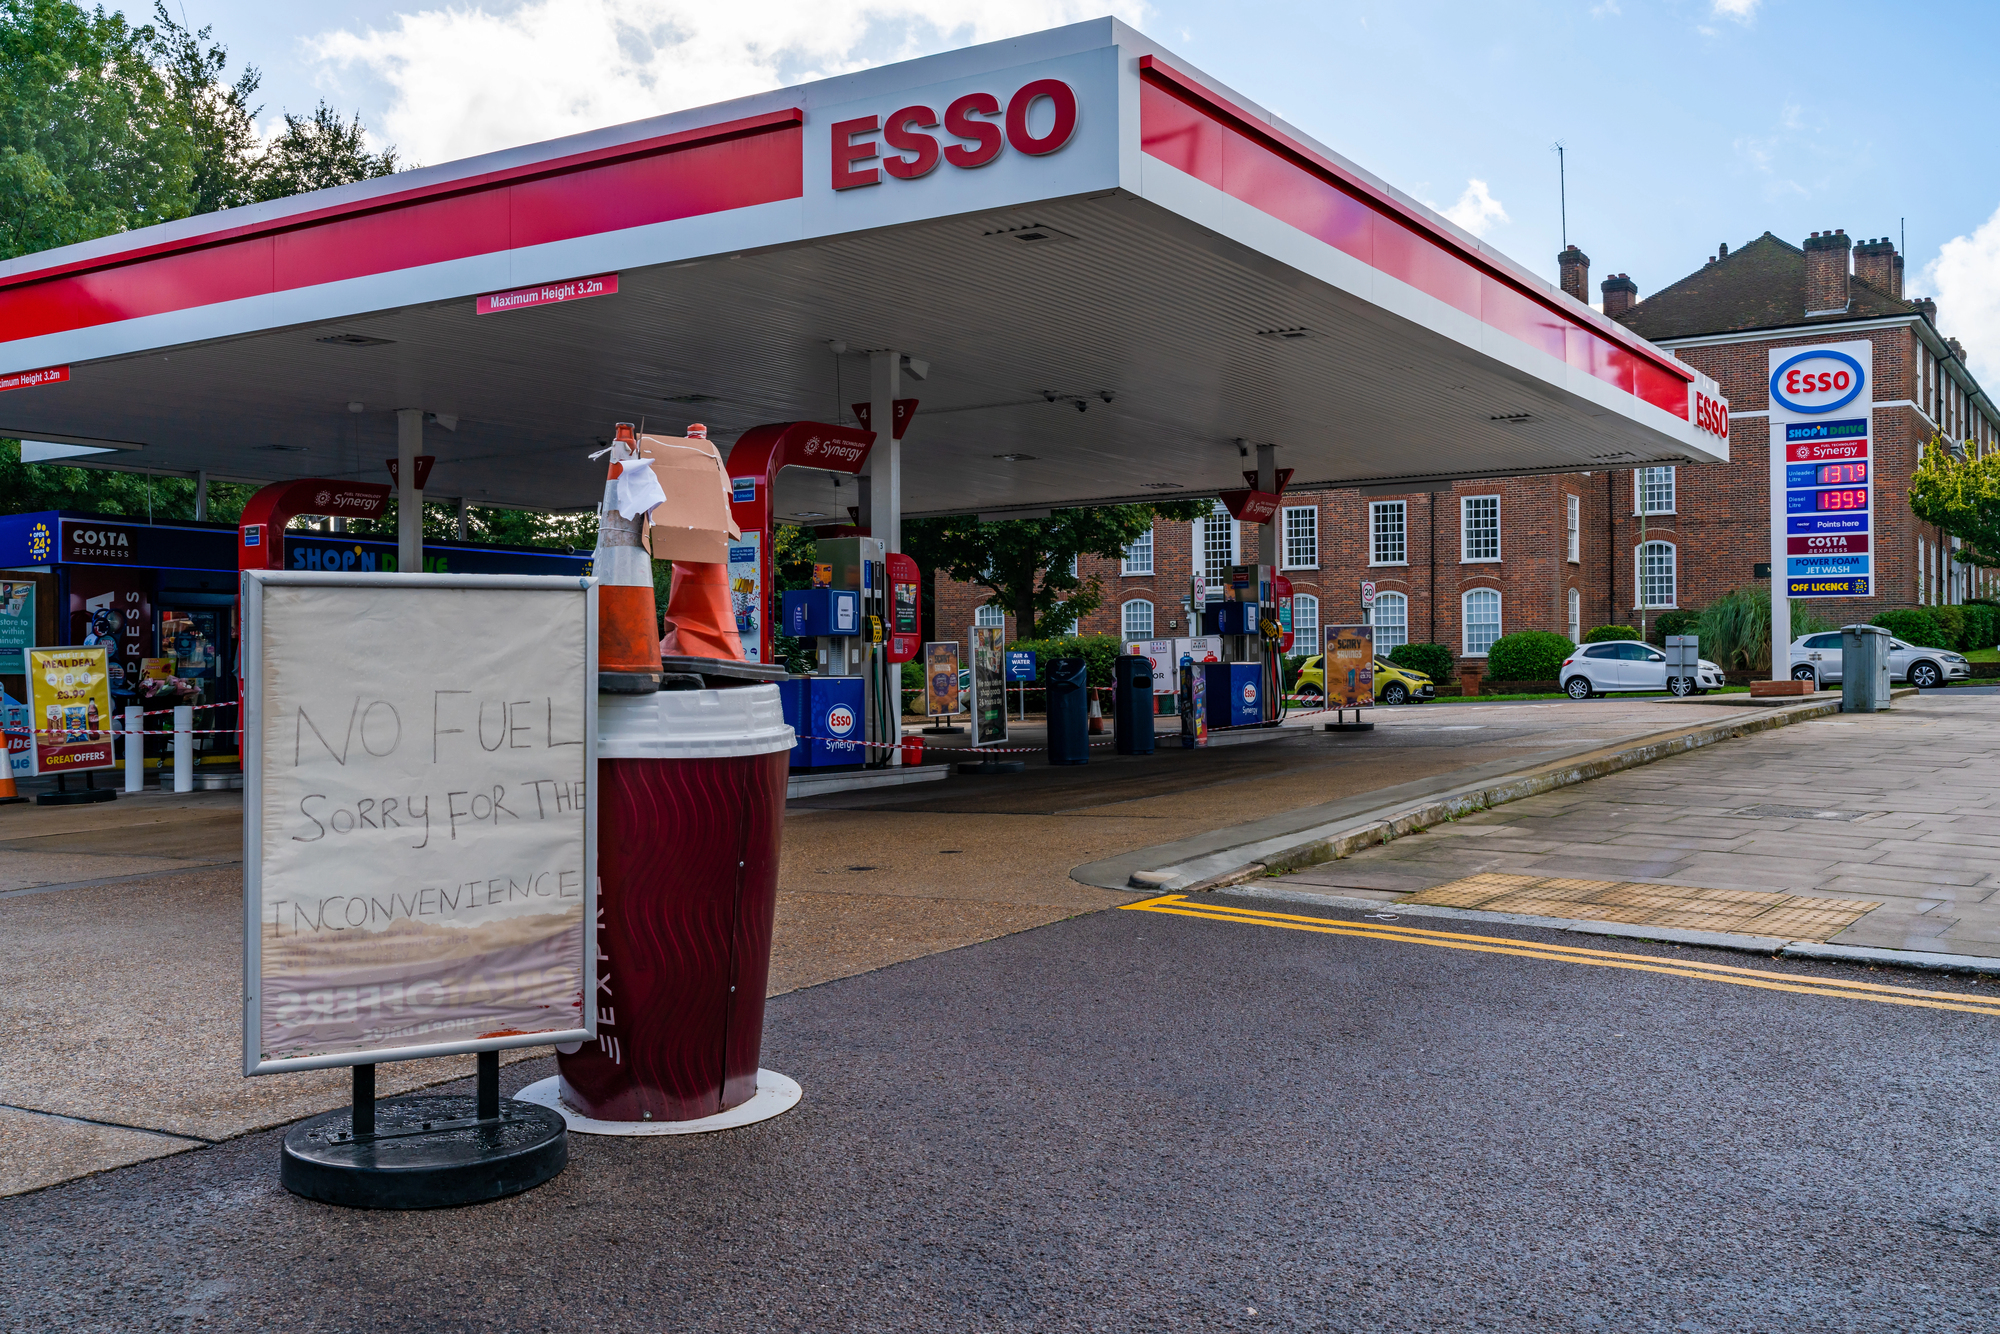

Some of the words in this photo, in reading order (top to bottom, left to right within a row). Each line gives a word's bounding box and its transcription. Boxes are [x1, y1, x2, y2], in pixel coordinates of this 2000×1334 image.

[831, 78, 1079, 191] ESSO
[490, 292, 539, 308] Maximum
[541, 284, 575, 300] Height
[578, 280, 603, 294] 3.2m
[20, 373, 43, 385] Height
[44, 370, 60, 381] 3.2m
[860, 408, 868, 419] 4
[897, 405, 904, 417] 3
[1696, 391, 1729, 438] ESSO
[1788, 425, 1828, 438] SHOP'N
[1829, 424, 1865, 435] DRIVE
[820, 441, 863, 462] Synergy
[1813, 446, 1858, 458] Synergy
[391, 463, 398, 474] 8
[417, 461, 423, 471] 7
[1249, 474, 1255, 483] 2
[1278, 473, 1284, 482] 1
[1824, 463, 1866, 483] 137.9
[333, 494, 379, 510] Synergy
[1824, 489, 1866, 509] 139.9
[33, 537, 46, 550] 24
[73, 529, 129, 547] COSTA
[1807, 537, 1848, 547] COSTA
[879, 541, 884, 550] 3
[82, 548, 129, 558] EXPRESS
[293, 545, 376, 573] SHOP'N
[381, 552, 448, 575] DVE
[1795, 558, 1830, 566] POWER
[1832, 557, 1860, 565] FOAM
[732, 578, 755, 594] WIN
[1197, 584, 1203, 595] 20
[1364, 588, 1373, 596] 20
[1791, 583, 1809, 592] OFF
[1811, 582, 1849, 591] LICENCE
[1, 627, 25, 635] within
[126, 592, 140, 705] XPRESS
[1337, 639, 1361, 649] SCARY
[1337, 650, 1362, 659] SAVINGS
[42, 660, 69, 669] MEAL
[71, 658, 96, 668] DEAL
[57, 689, 85, 700] £3.99
[1242, 706, 1258, 715] Synergy
[295, 695, 401, 767] NO
[433, 690, 584, 764] FUEL
[826, 740, 855, 752] Synergy
[292, 794, 429, 849] SORRY
[447, 785, 519, 840] FOR
[521, 780, 586, 819] THE
[268, 871, 579, 938] INCONVENIENCE
